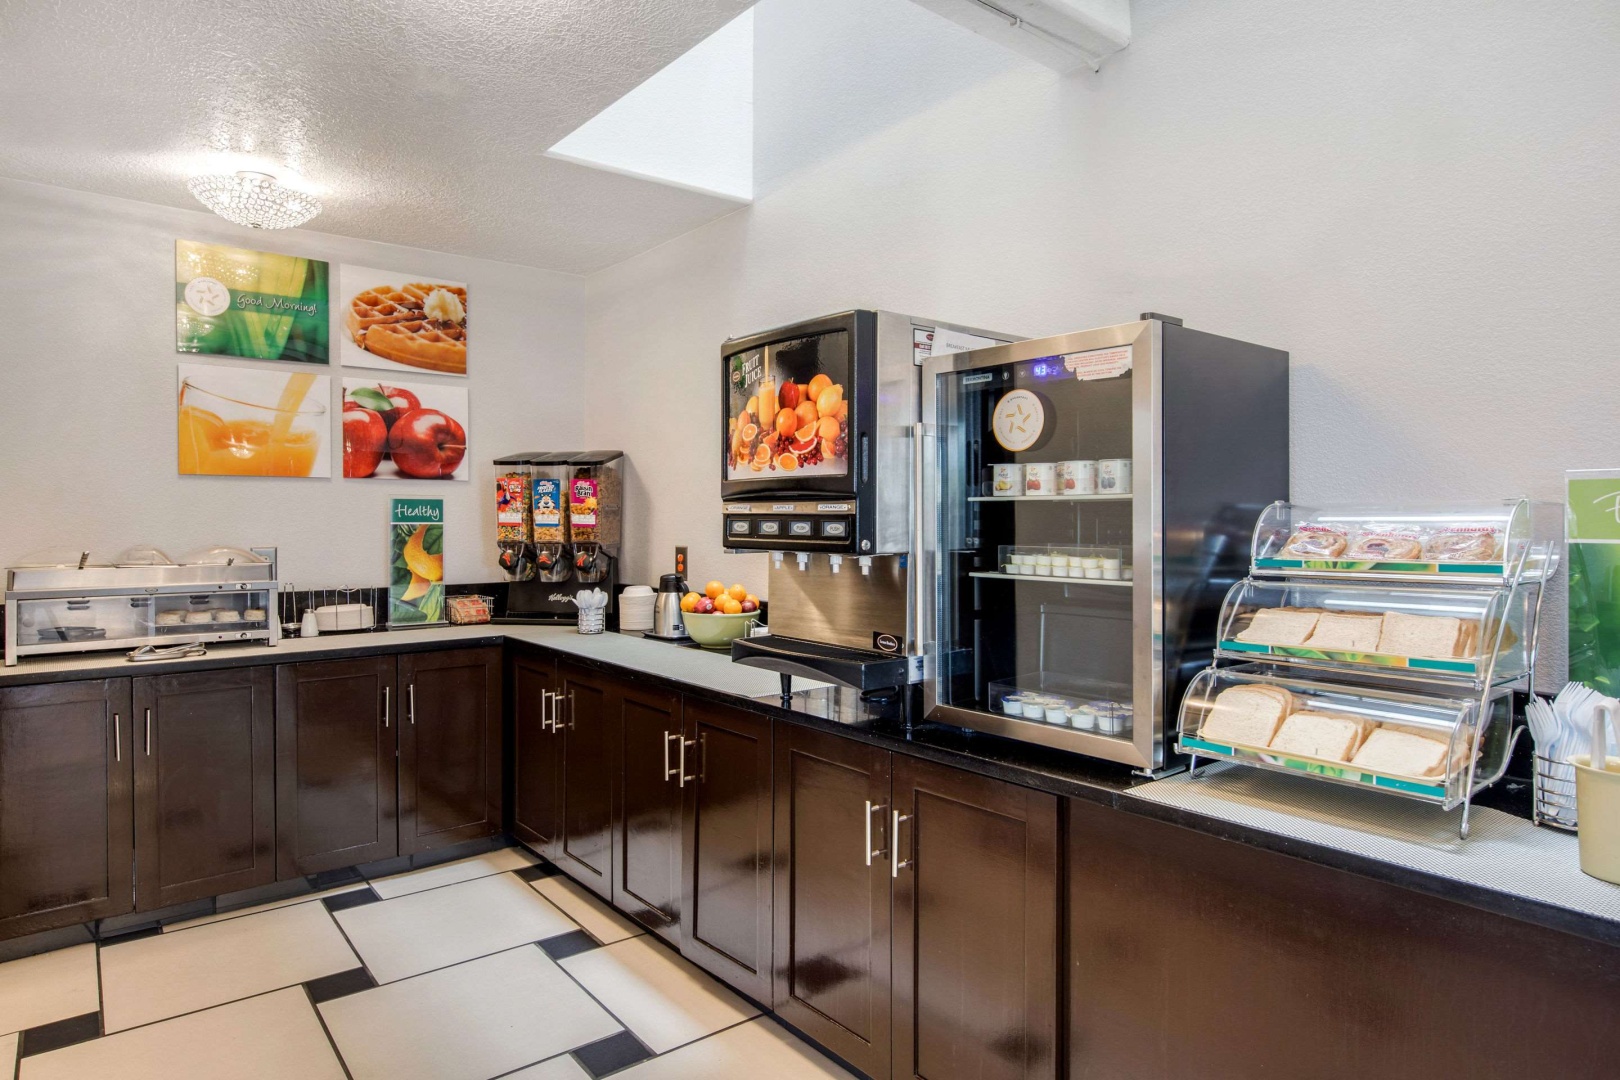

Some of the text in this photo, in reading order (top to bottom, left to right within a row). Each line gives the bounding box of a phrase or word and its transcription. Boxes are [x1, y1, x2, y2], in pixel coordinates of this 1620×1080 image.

[237, 294, 262, 309] Good
[265, 298, 317, 316] Morning!
[742, 354, 760, 376] FRUIT
[1035, 365, 1047, 375] 43
[744, 366, 762, 388] JUICE
[394, 503, 440, 521] Healthy
